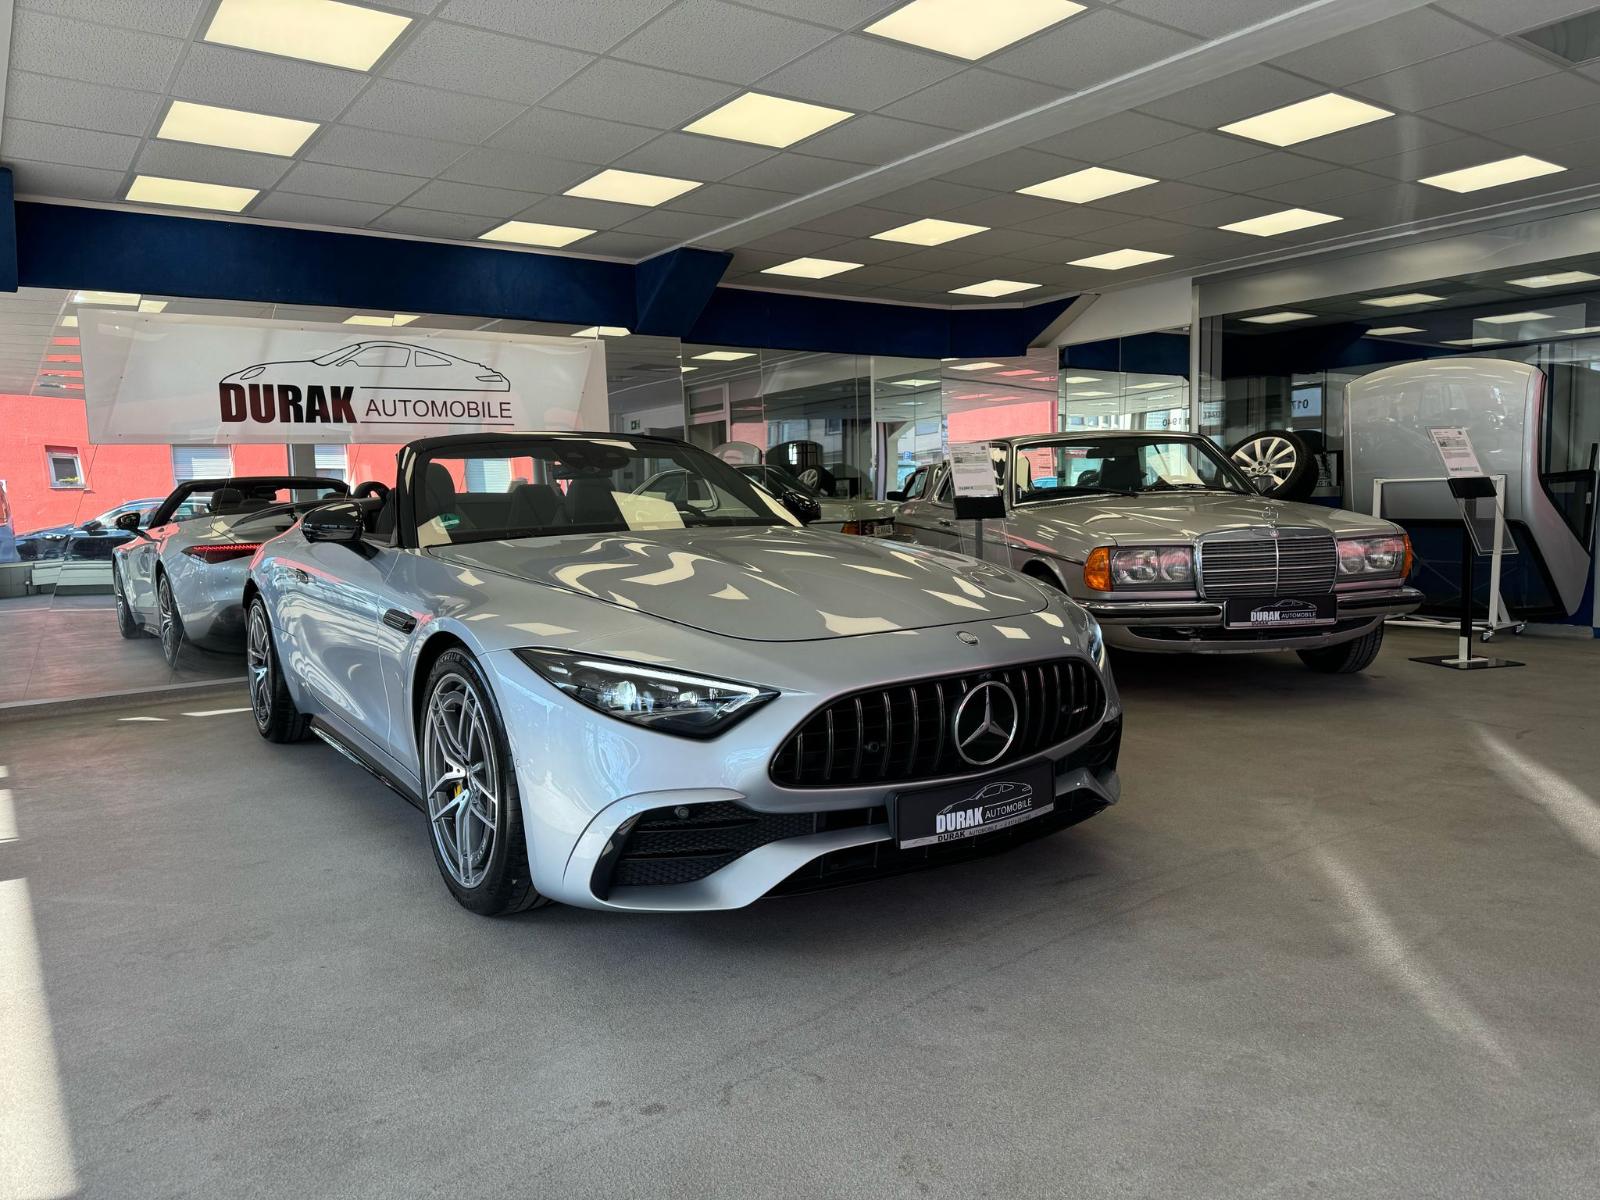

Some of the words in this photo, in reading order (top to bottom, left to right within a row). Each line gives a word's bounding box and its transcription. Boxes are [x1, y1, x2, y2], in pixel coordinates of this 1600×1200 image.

[219, 382, 357, 424] DURAK
[366, 400, 513, 419] AUTOMOBILE
[1251, 611, 1281, 622] DURAK
[936, 807, 983, 833] DURAK
[985, 798, 1032, 819] AUTOMOBILE
[937, 831, 966, 842] DURAK
